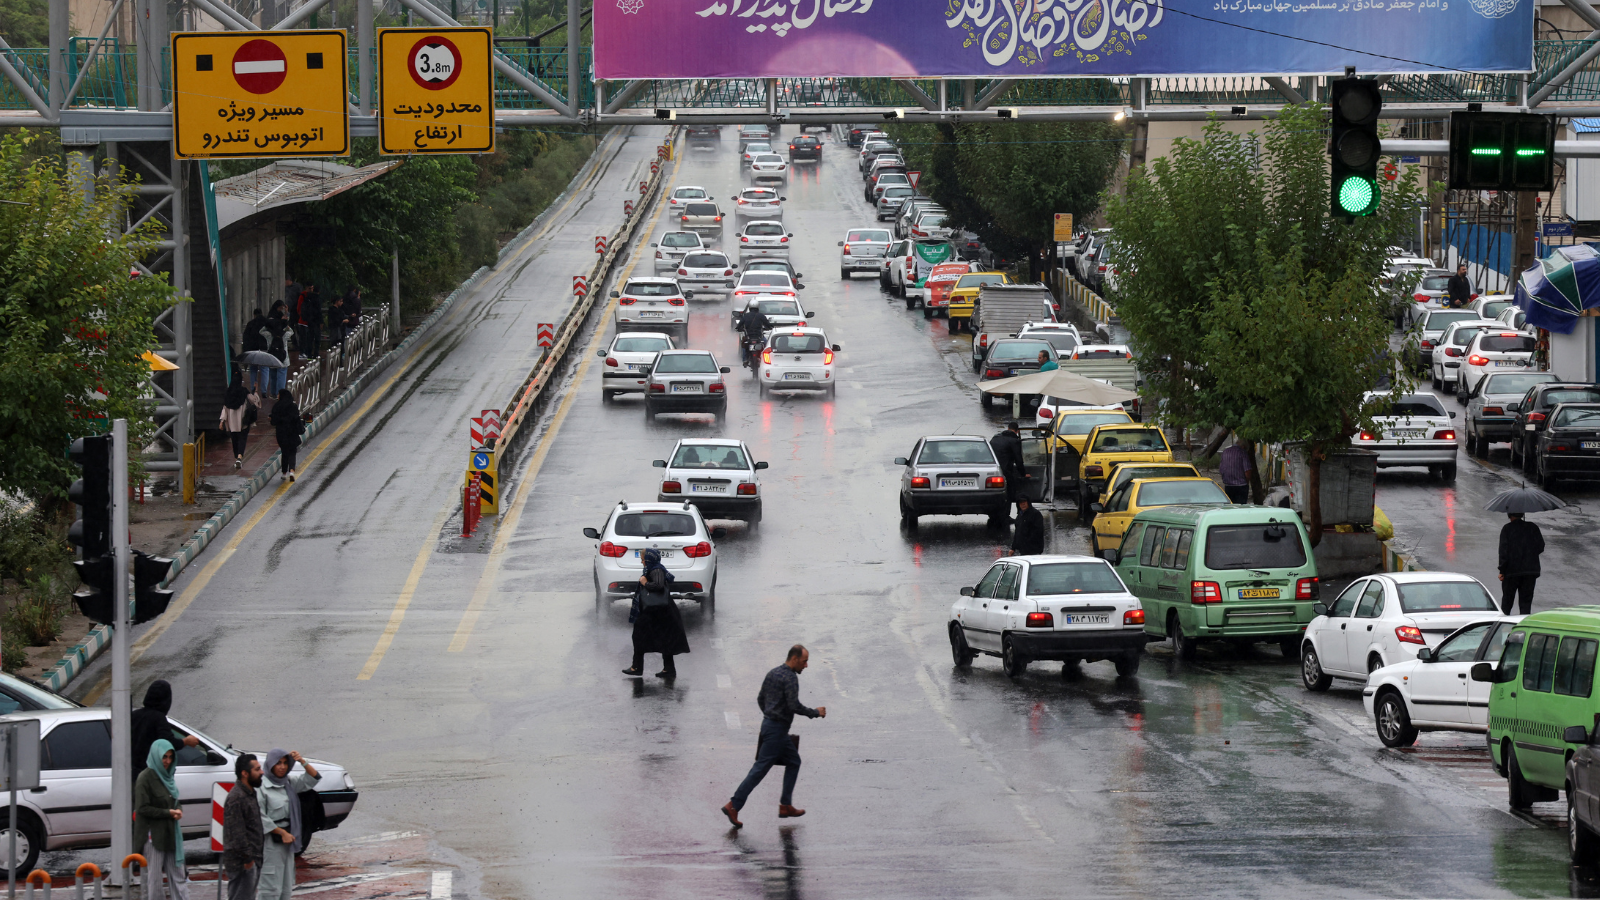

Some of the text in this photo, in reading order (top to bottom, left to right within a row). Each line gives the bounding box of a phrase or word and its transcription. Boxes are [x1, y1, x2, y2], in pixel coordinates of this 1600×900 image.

[1213, 0, 1228, 13] باد
[1230, 0, 1262, 13] مبارک
[1263, 0, 1292, 13] جهان
[1292, 0, 1338, 13] مسلمین
[1338, 0, 1351, 12] بر
[1352, 0, 1385, 12] صادق
[1385, 0, 1415, 12] جعفر
[1418, 0, 1440, 13] امام
[419, 53, 451, 74] 3.8m
[217, 101, 304, 121] مسیر ویژه
[393, 102, 482, 118] محدودیت
[202, 127, 324, 149] اتوبوس تندرو
[414, 125, 462, 147] ارتفاع
